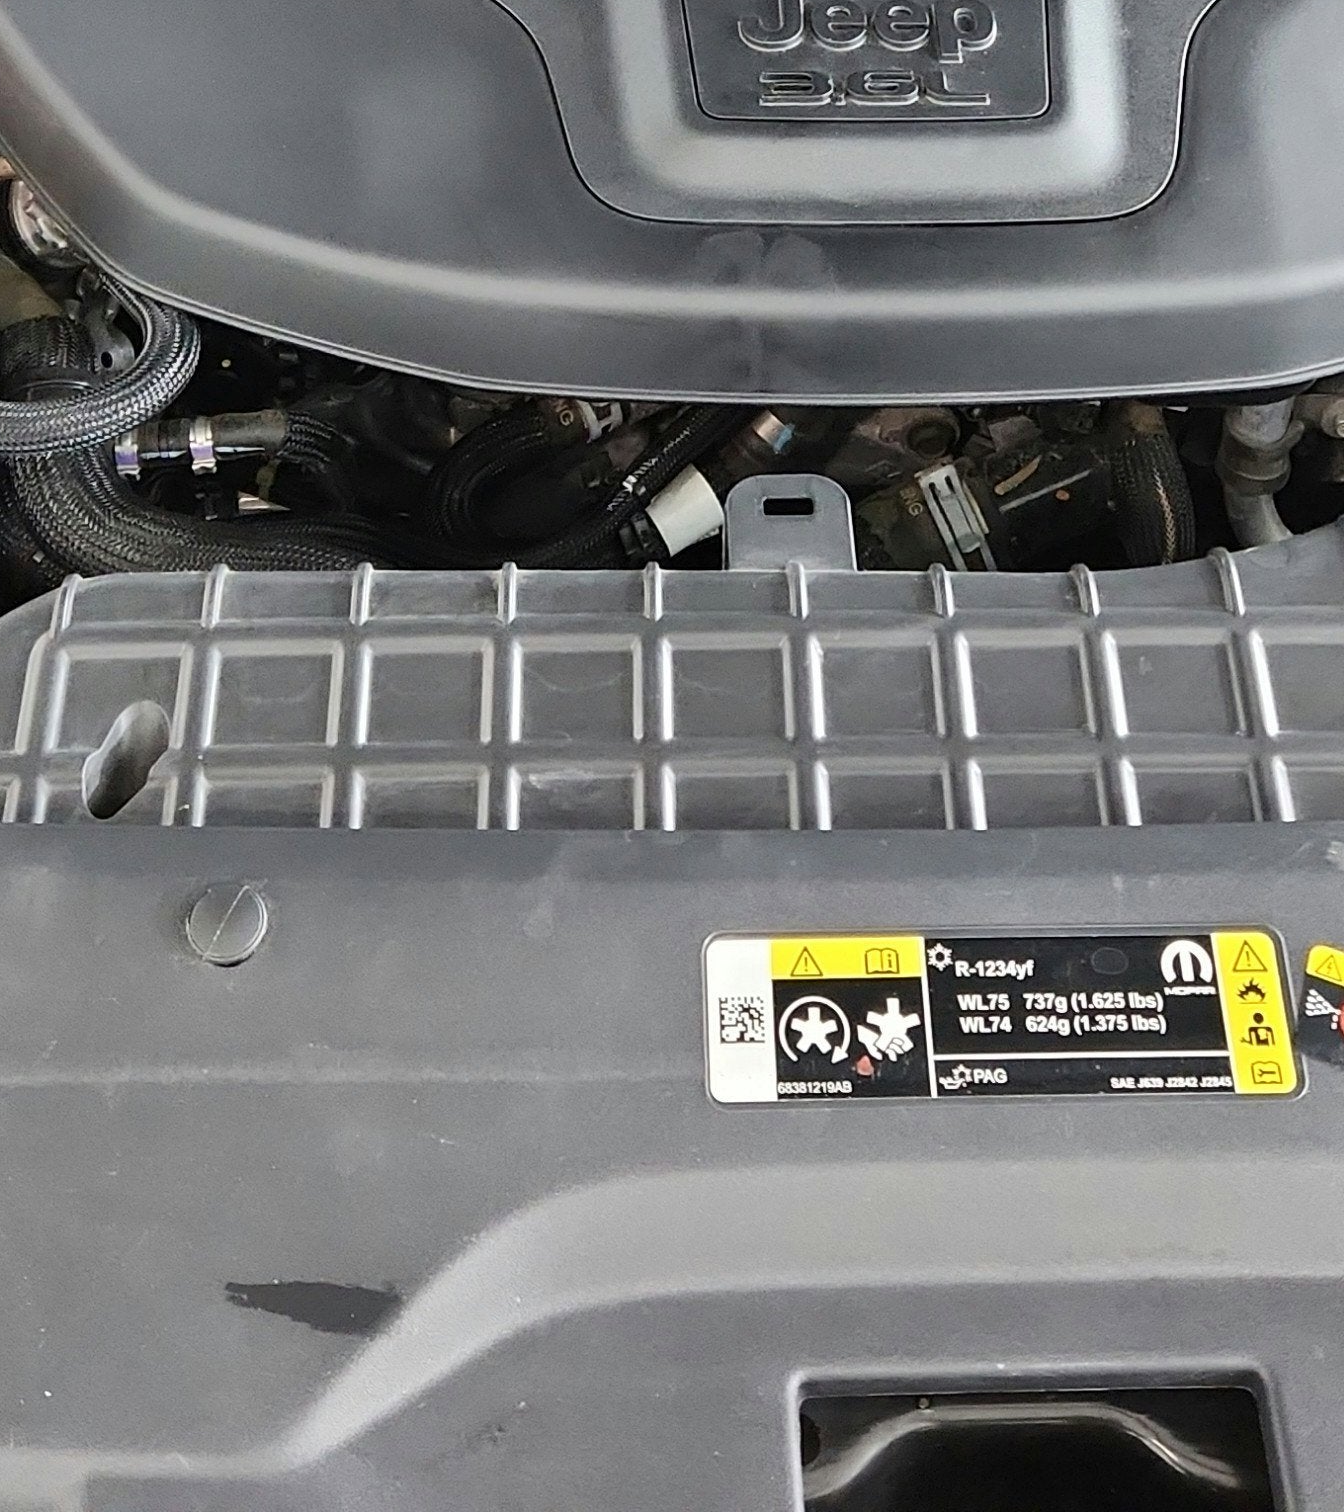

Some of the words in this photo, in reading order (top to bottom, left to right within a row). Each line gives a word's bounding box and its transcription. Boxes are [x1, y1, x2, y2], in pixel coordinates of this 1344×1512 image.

[759, 69, 990, 107] 3.6L
[954, 959, 1035, 980] R-1234yf
[957, 994, 1010, 1010] WL75
[1022, 993, 1067, 1013] 737g
[1071, 992, 1126, 1013] (1.625
[1129, 991, 1164, 1012] lbs)
[959, 1016, 1012, 1033] WL74
[1025, 1016, 1071, 1036] 624g
[1073, 1015, 1129, 1036] (1.375
[1131, 1014, 1167, 1035] lbs)
[973, 1068, 1007, 1084] PAG
[1110, 1077, 1136, 1089] SAE
[777, 1081, 852, 1094] 68381219AB
